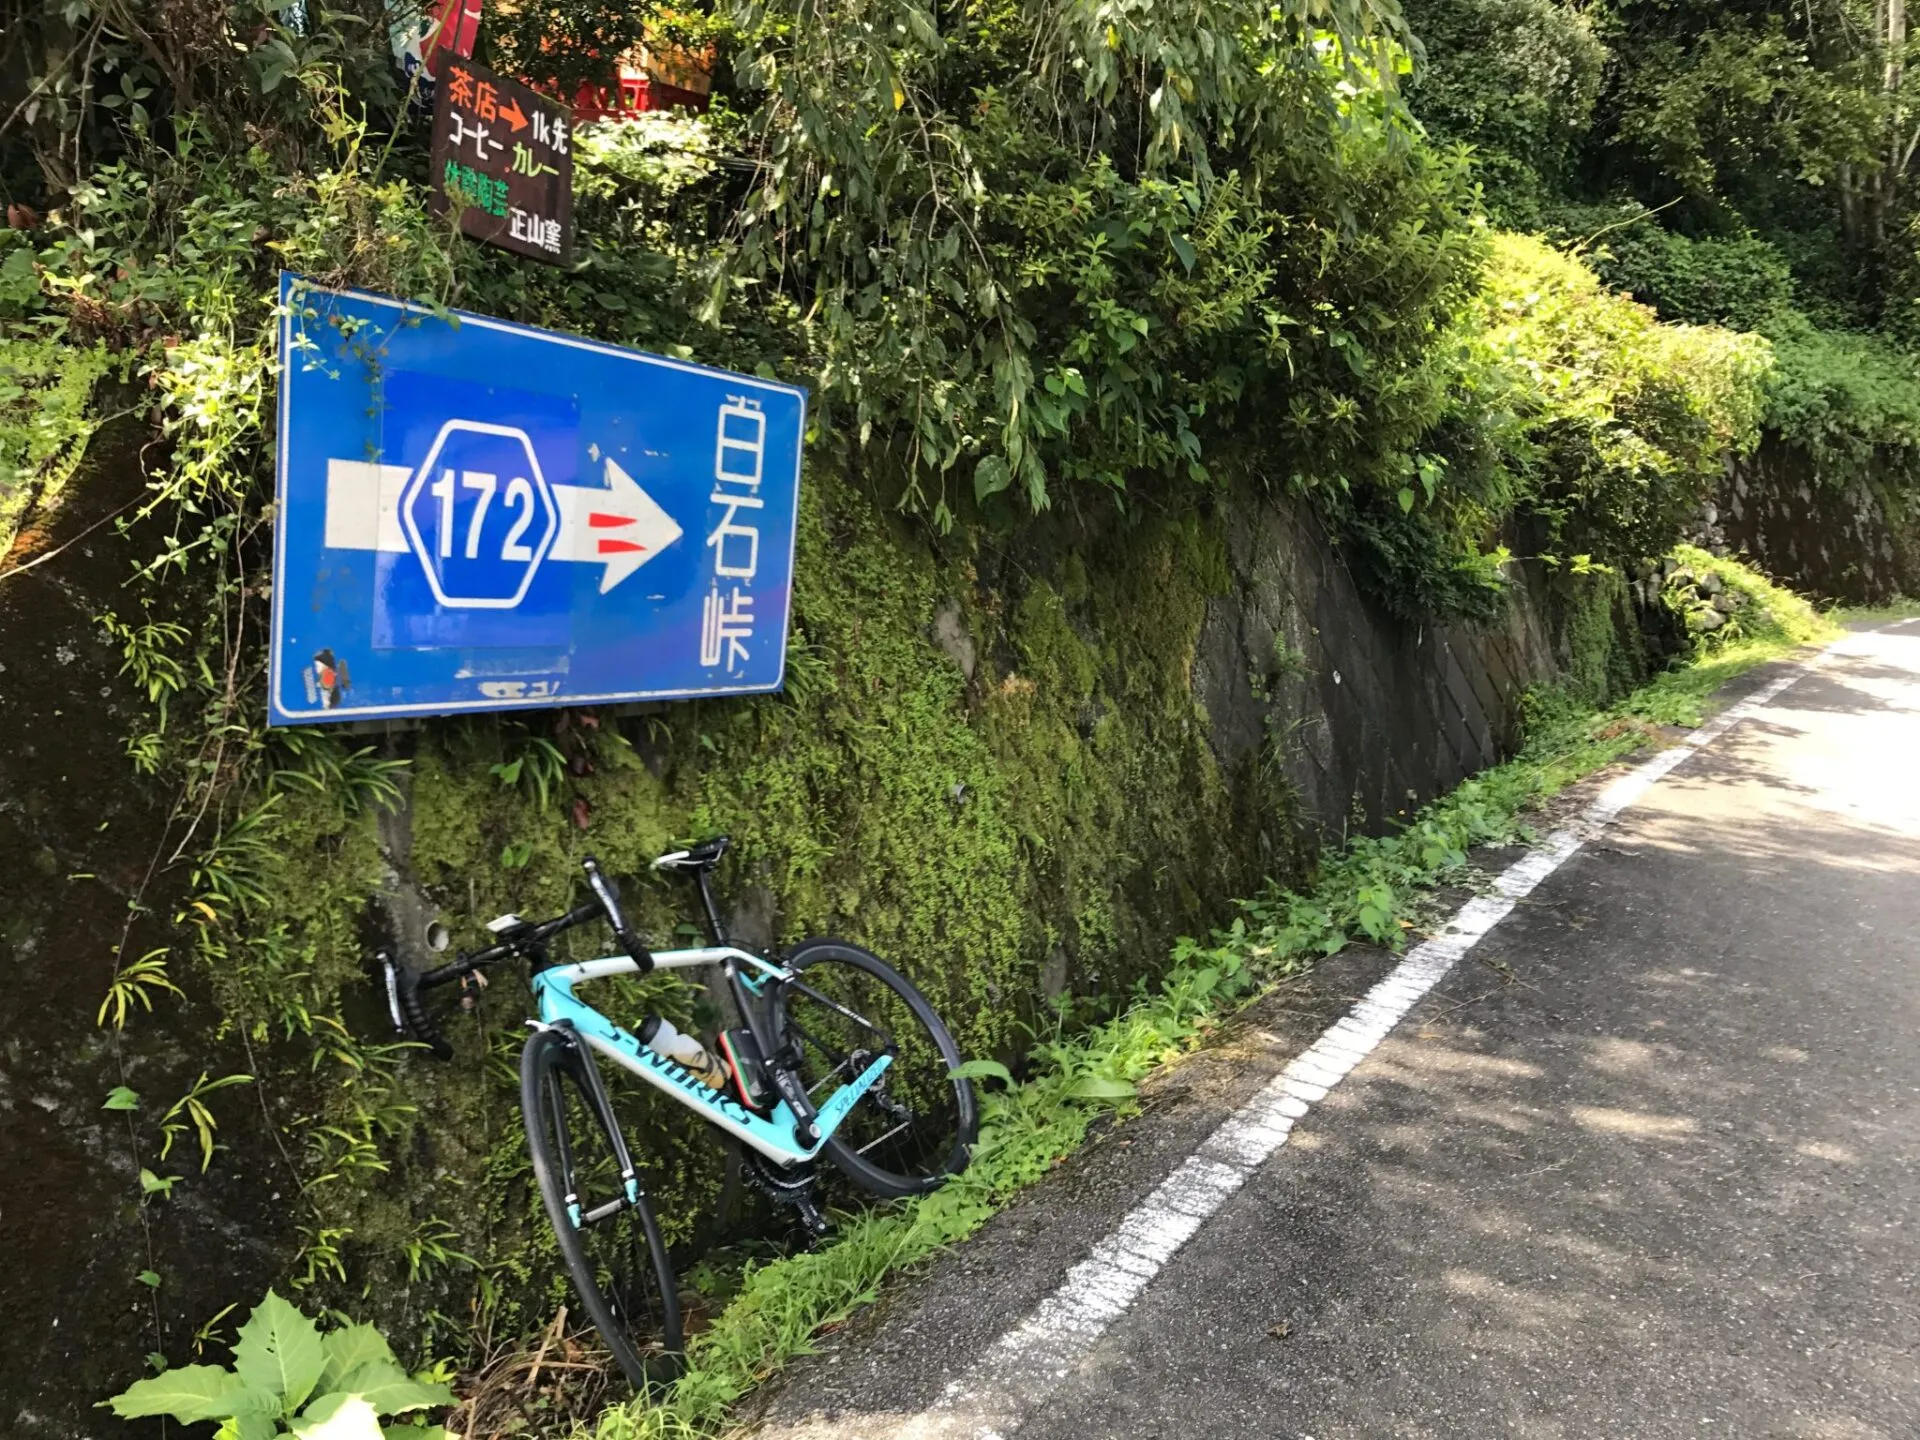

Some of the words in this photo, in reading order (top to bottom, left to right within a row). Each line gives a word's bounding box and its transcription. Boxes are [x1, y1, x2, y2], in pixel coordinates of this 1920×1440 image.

[449, 66, 498, 123] 茶店
[531, 110, 568, 155] 1k先
[513, 142, 560, 177] カレー
[432, 470, 535, 561] 172
[700, 396, 766, 673] 白石峠
